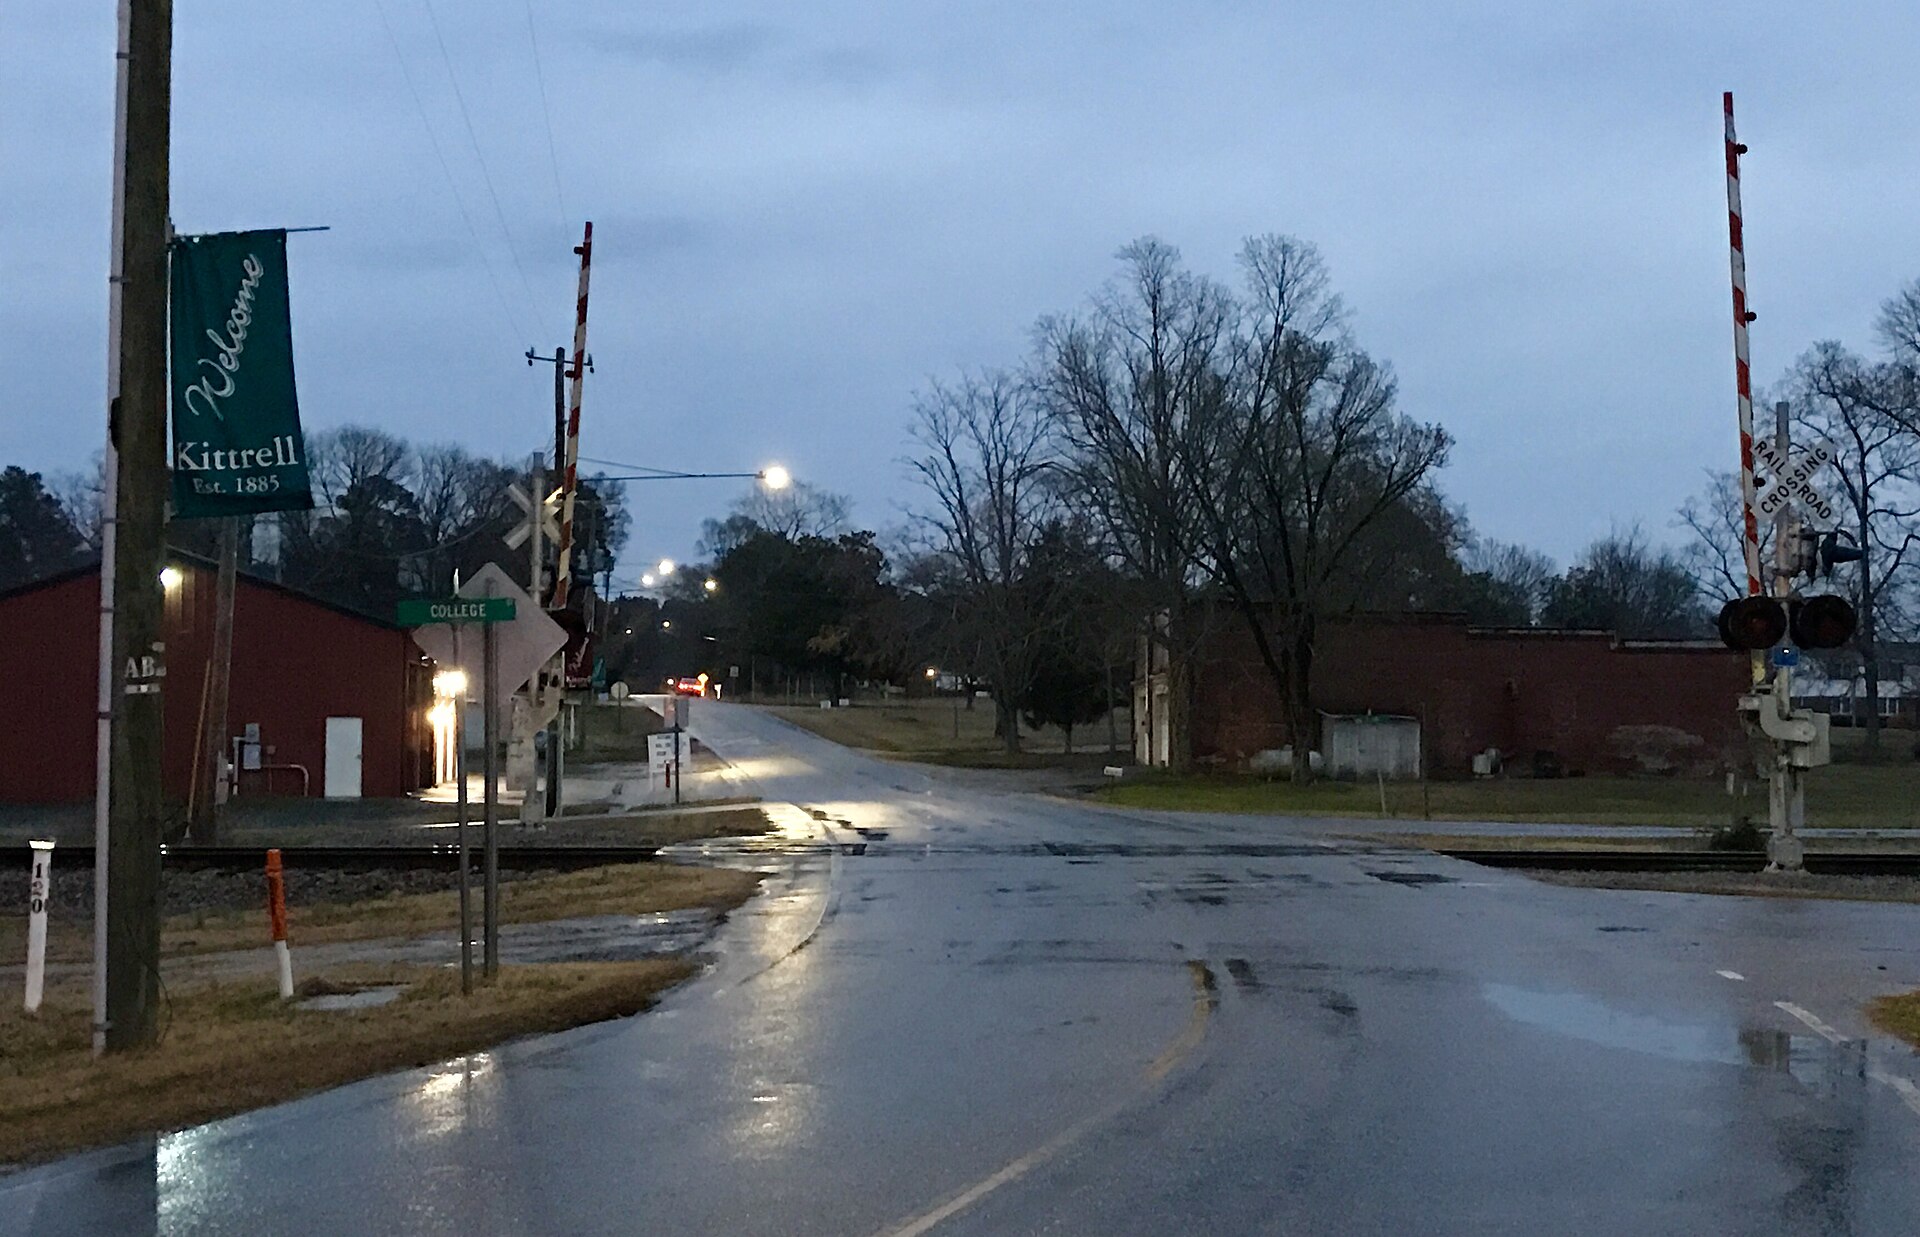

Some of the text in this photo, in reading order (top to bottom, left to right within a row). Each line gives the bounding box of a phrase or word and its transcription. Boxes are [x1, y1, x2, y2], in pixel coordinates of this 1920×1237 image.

[184, 253, 265, 421] Welcome
[177, 435, 299, 471] Kittrell
[193, 475, 280, 494] Est. 1885
[1755, 441, 1832, 519] RAIL ROAD
[1760, 447, 1829, 514] CROSSING
[430, 603, 487, 618] COLLEGE
